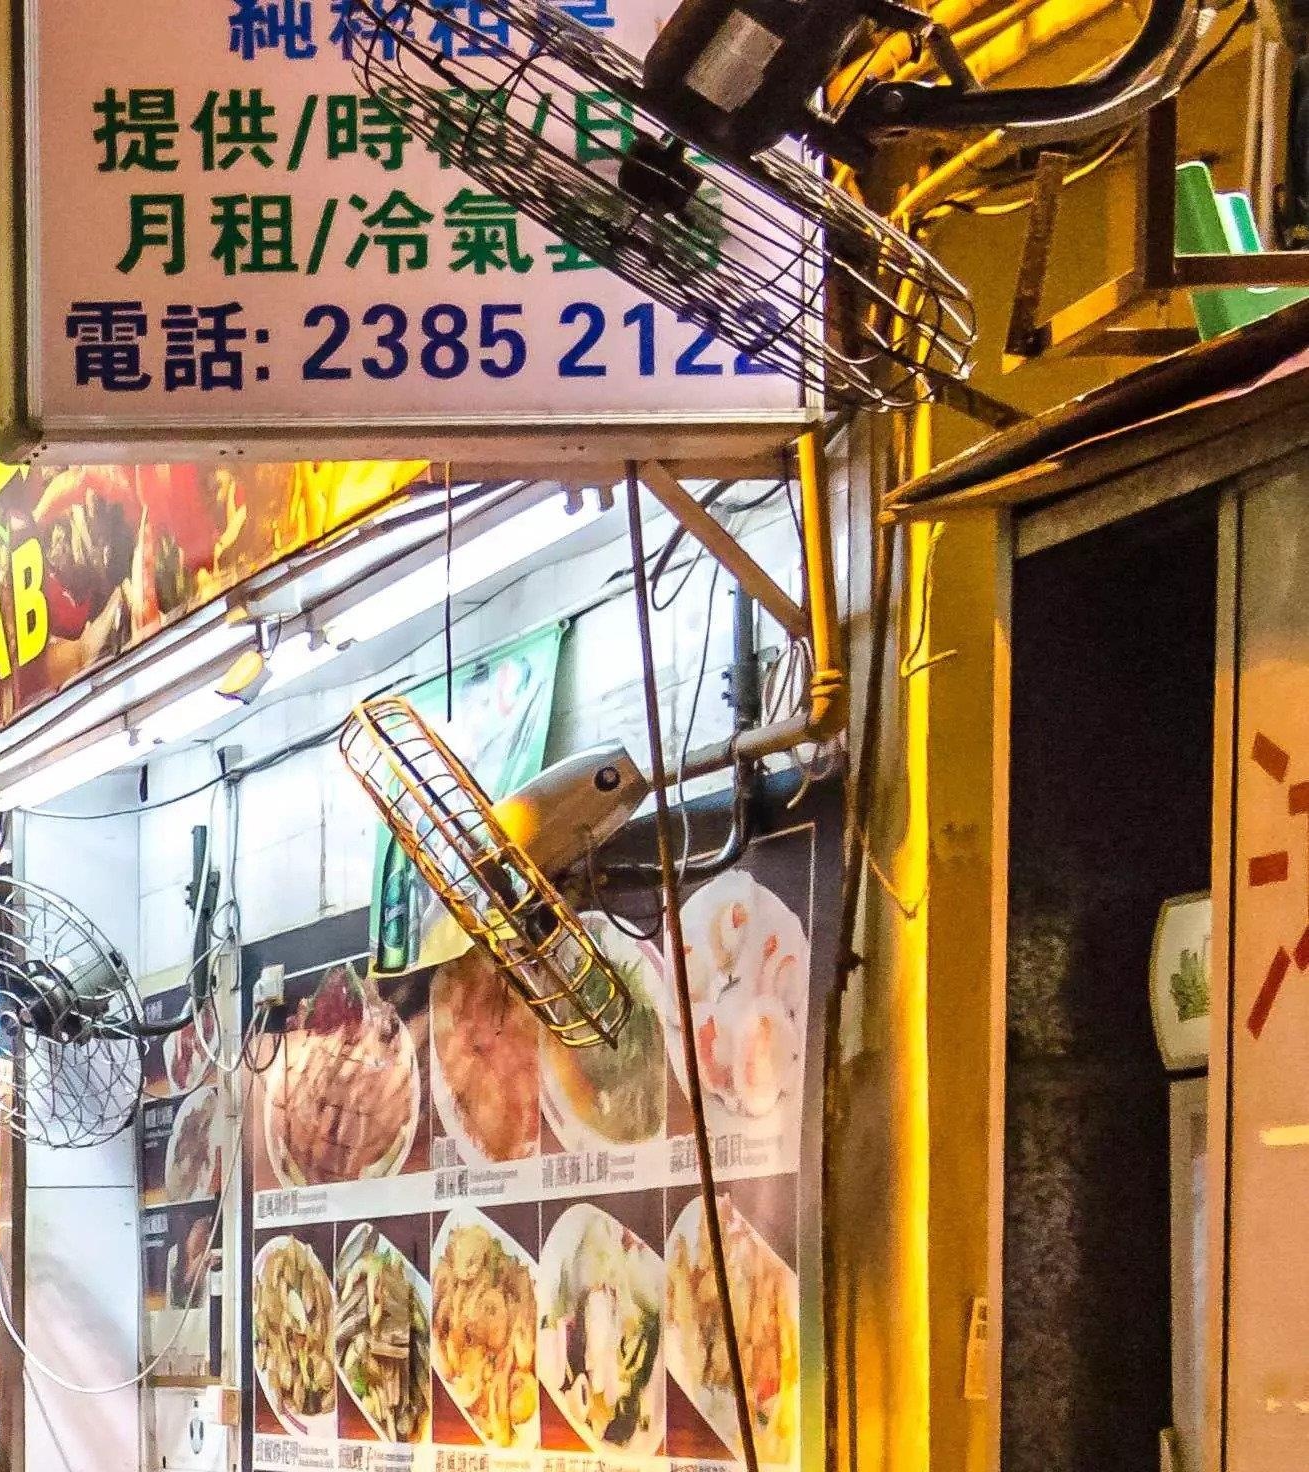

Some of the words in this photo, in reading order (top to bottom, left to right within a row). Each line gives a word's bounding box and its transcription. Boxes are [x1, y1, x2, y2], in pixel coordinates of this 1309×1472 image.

[64, 301, 270, 392] 電話:
[301, 302, 527, 381] 2385
[558, 301, 783, 377] 2122
